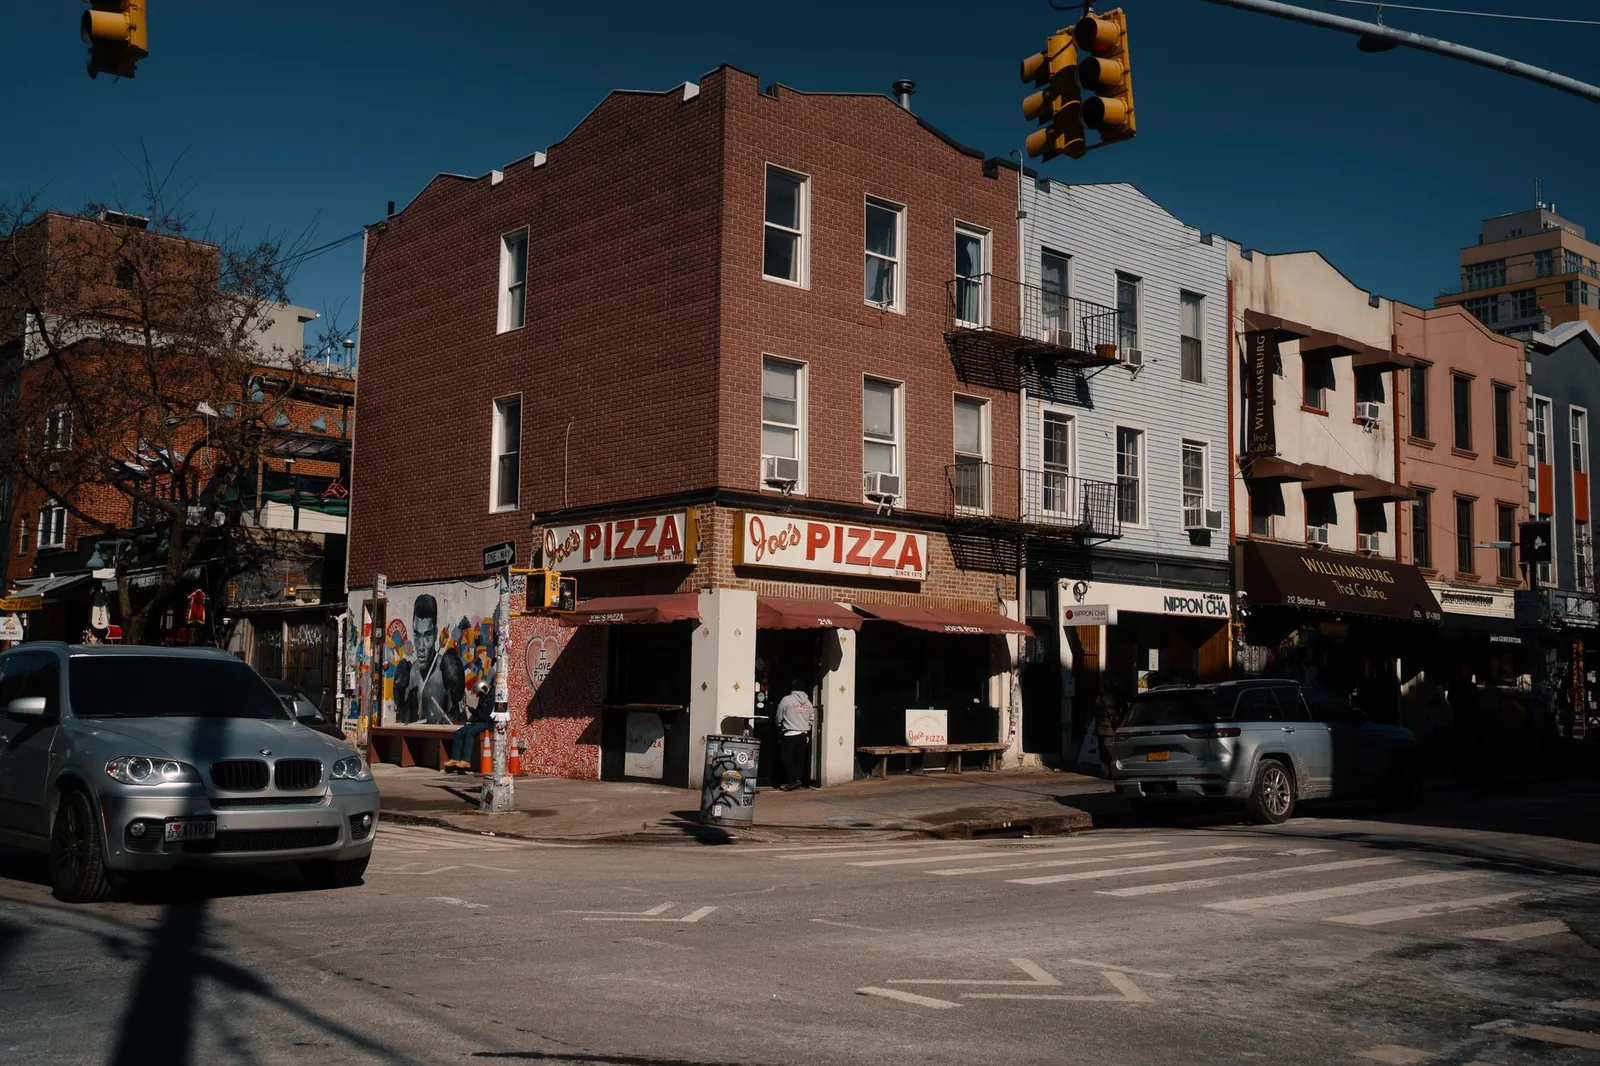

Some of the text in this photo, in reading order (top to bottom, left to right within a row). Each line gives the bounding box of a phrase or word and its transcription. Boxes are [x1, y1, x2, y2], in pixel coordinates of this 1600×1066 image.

[1255, 335, 1266, 430] WILLIAMSBURG
[545, 516, 682, 571] Joe's PIZZA
[749, 515, 923, 571] Joe's PIZZA
[1300, 556, 1395, 584] WILLIAMSBURG
[1331, 579, 1355, 596] Thai
[1354, 583, 1388, 600] Cuisine
[1163, 596, 1228, 616] NIPPON CHA
[1286, 595, 1296, 604] 212
[1296, 596, 1316, 606] Bedford
[589, 612, 624, 623] JOE'S PIZZA
[534, 658, 552, 670] Love
[925, 735, 945, 743] PIZZA
